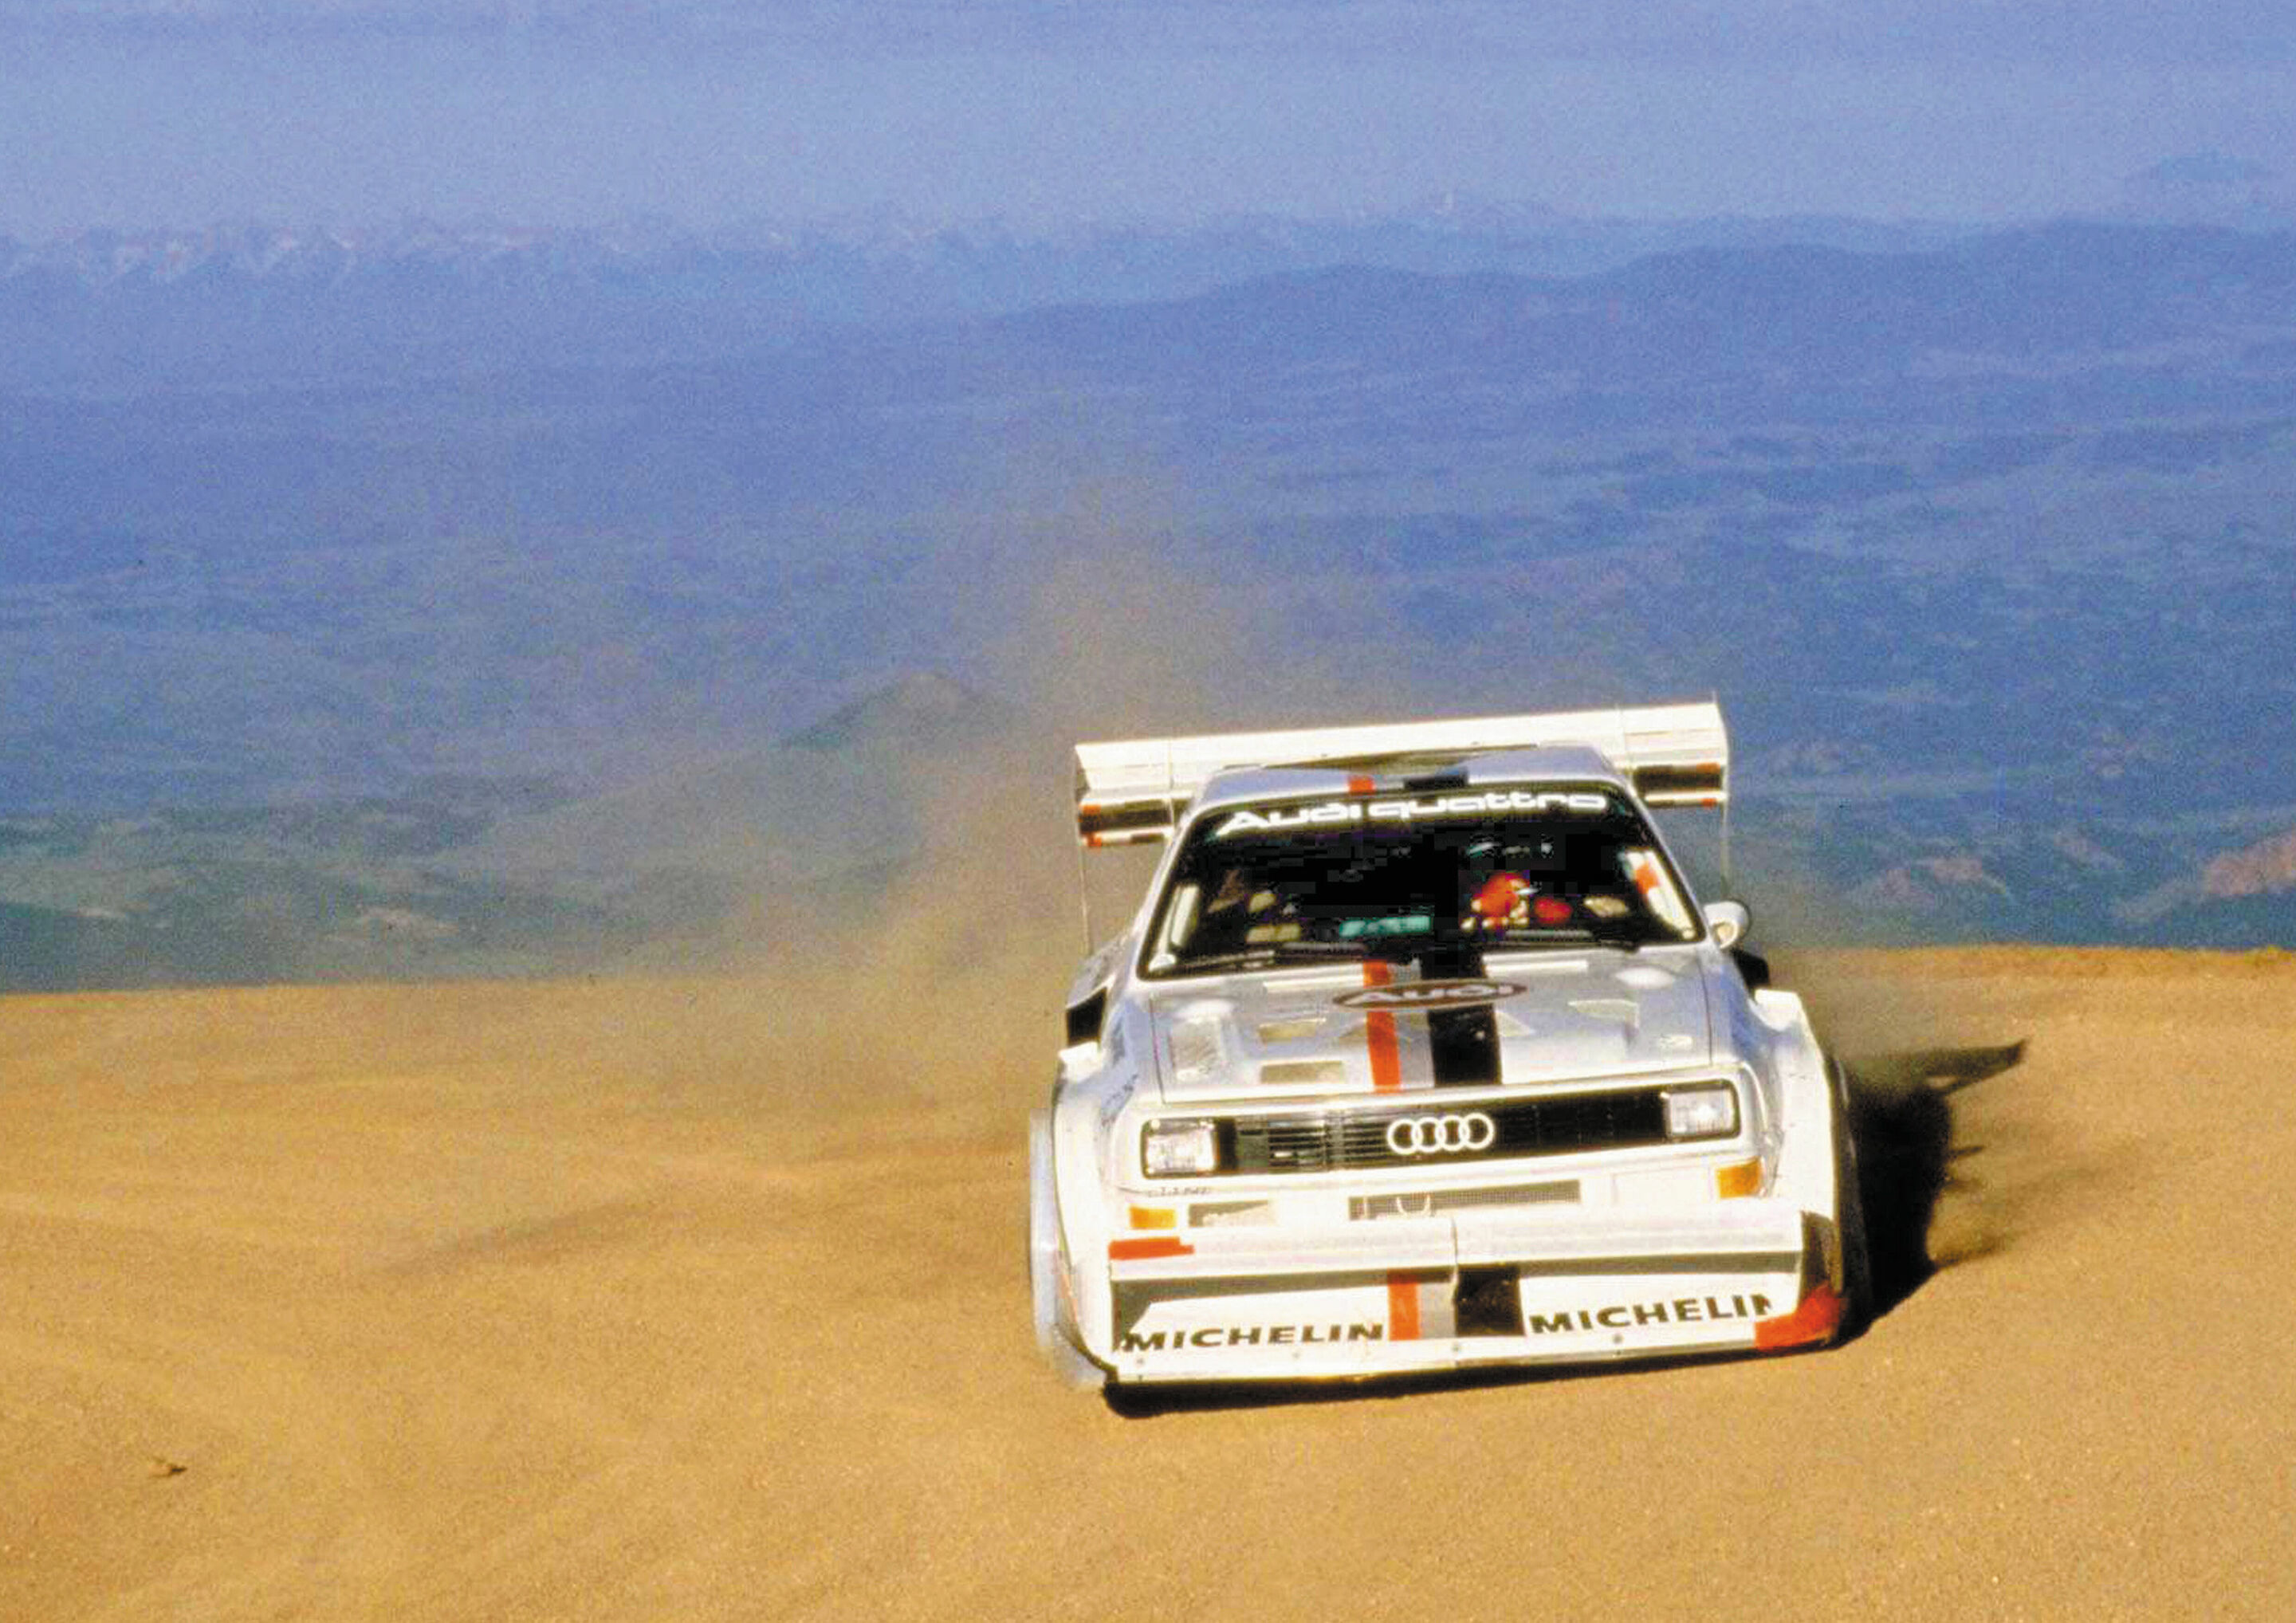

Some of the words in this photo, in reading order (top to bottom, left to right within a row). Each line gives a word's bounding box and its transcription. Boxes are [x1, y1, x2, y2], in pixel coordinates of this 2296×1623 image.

[1214, 802, 1362, 837] Audi
[1367, 792, 1606, 819] quattro
[1121, 1323, 1383, 1352] MICHELIN
